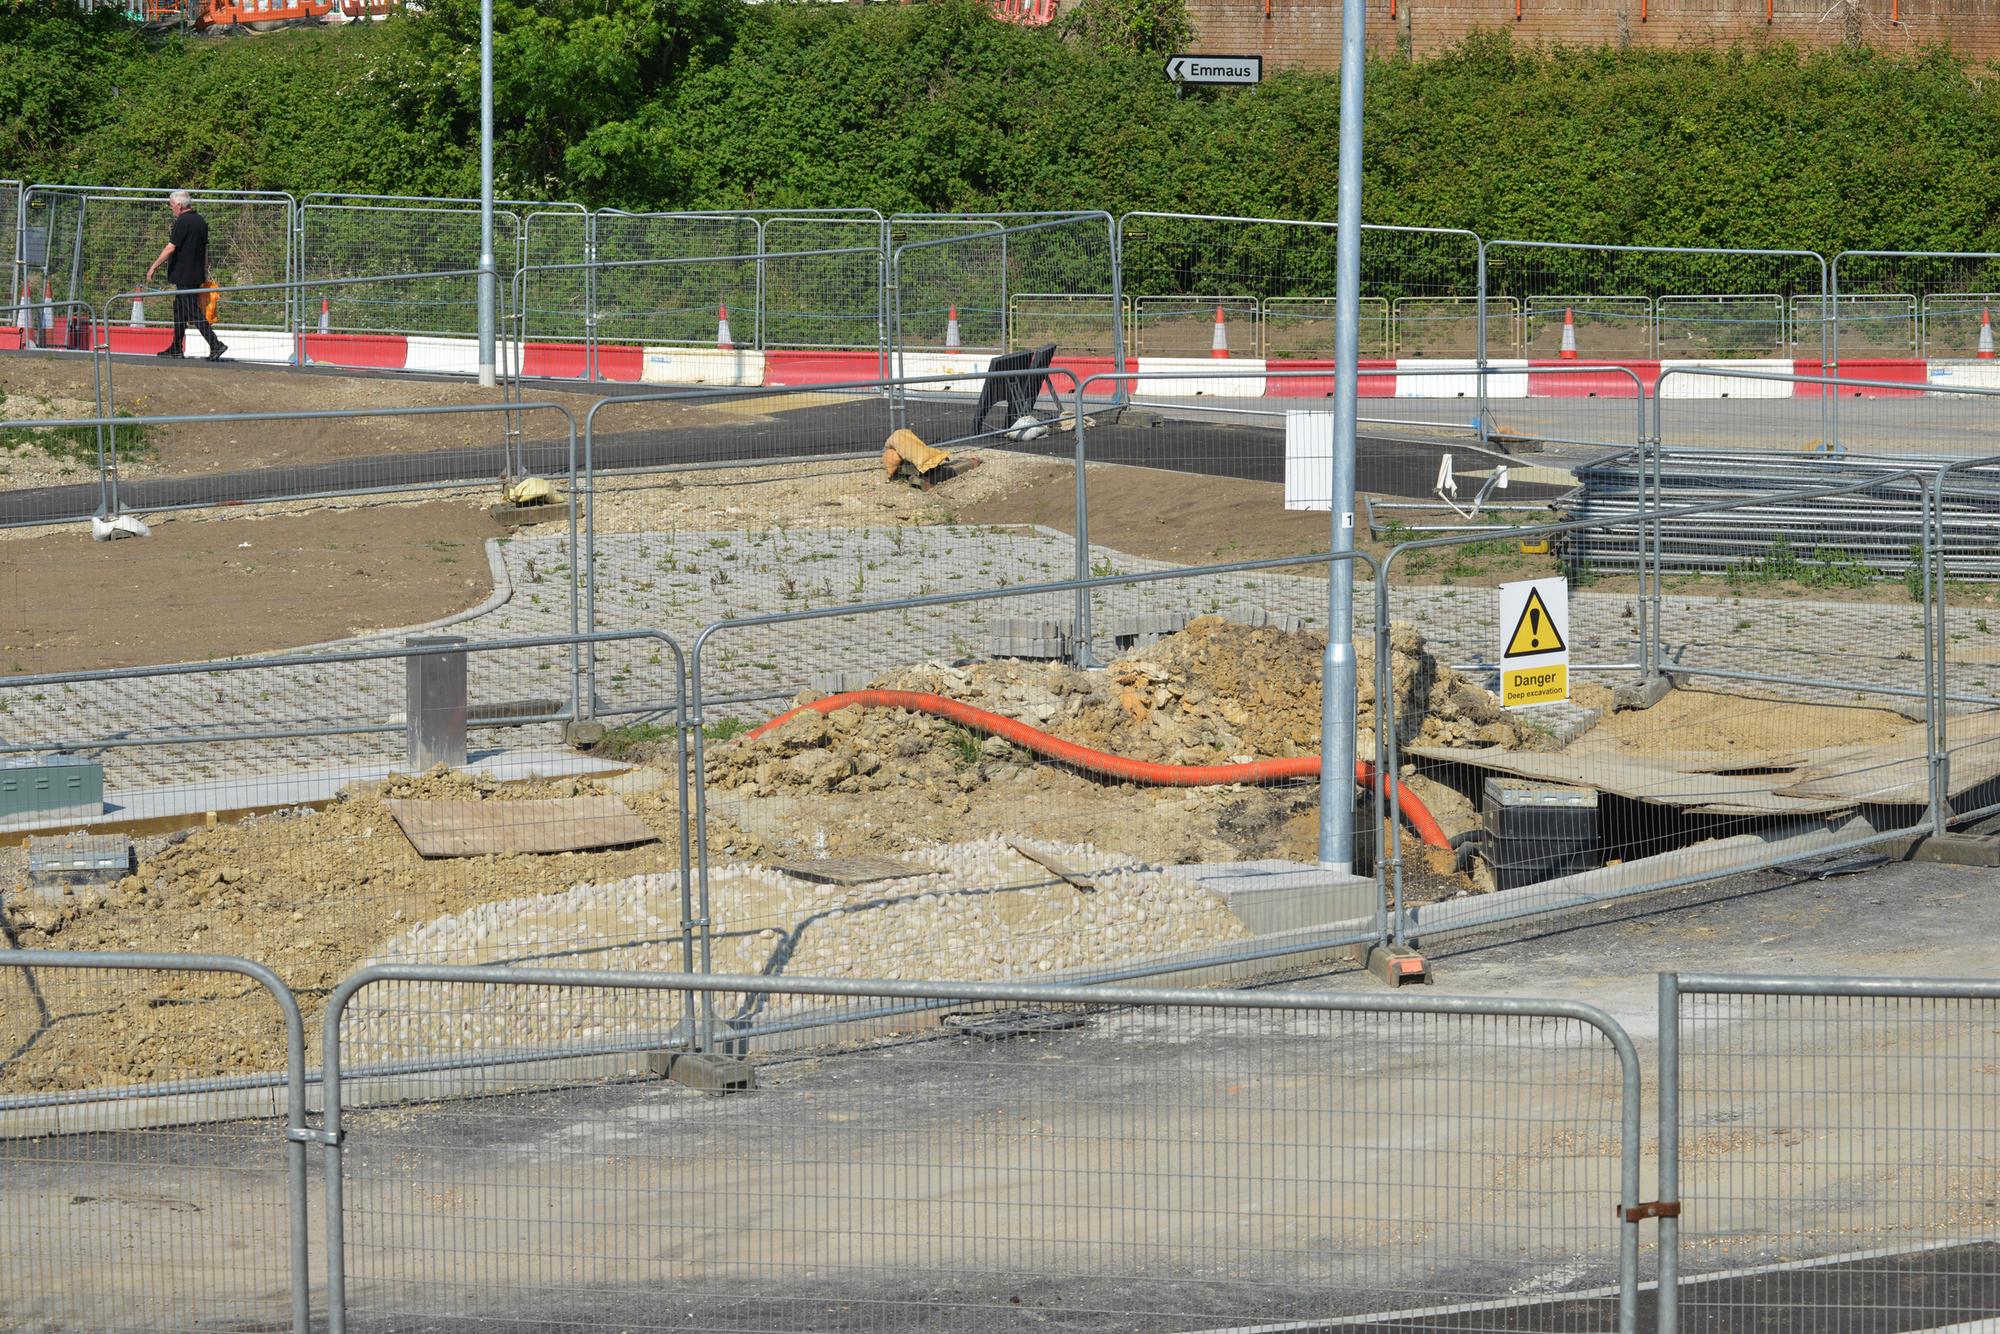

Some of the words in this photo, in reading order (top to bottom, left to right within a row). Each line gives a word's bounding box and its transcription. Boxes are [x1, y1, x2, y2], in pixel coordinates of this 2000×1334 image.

[1191, 63, 1251, 77] Emmaus
[1347, 514, 1352, 526] 1
[1514, 673, 1556, 687] Danger
[1507, 692, 1525, 700] Deep
[1526, 687, 1563, 697] excavation
